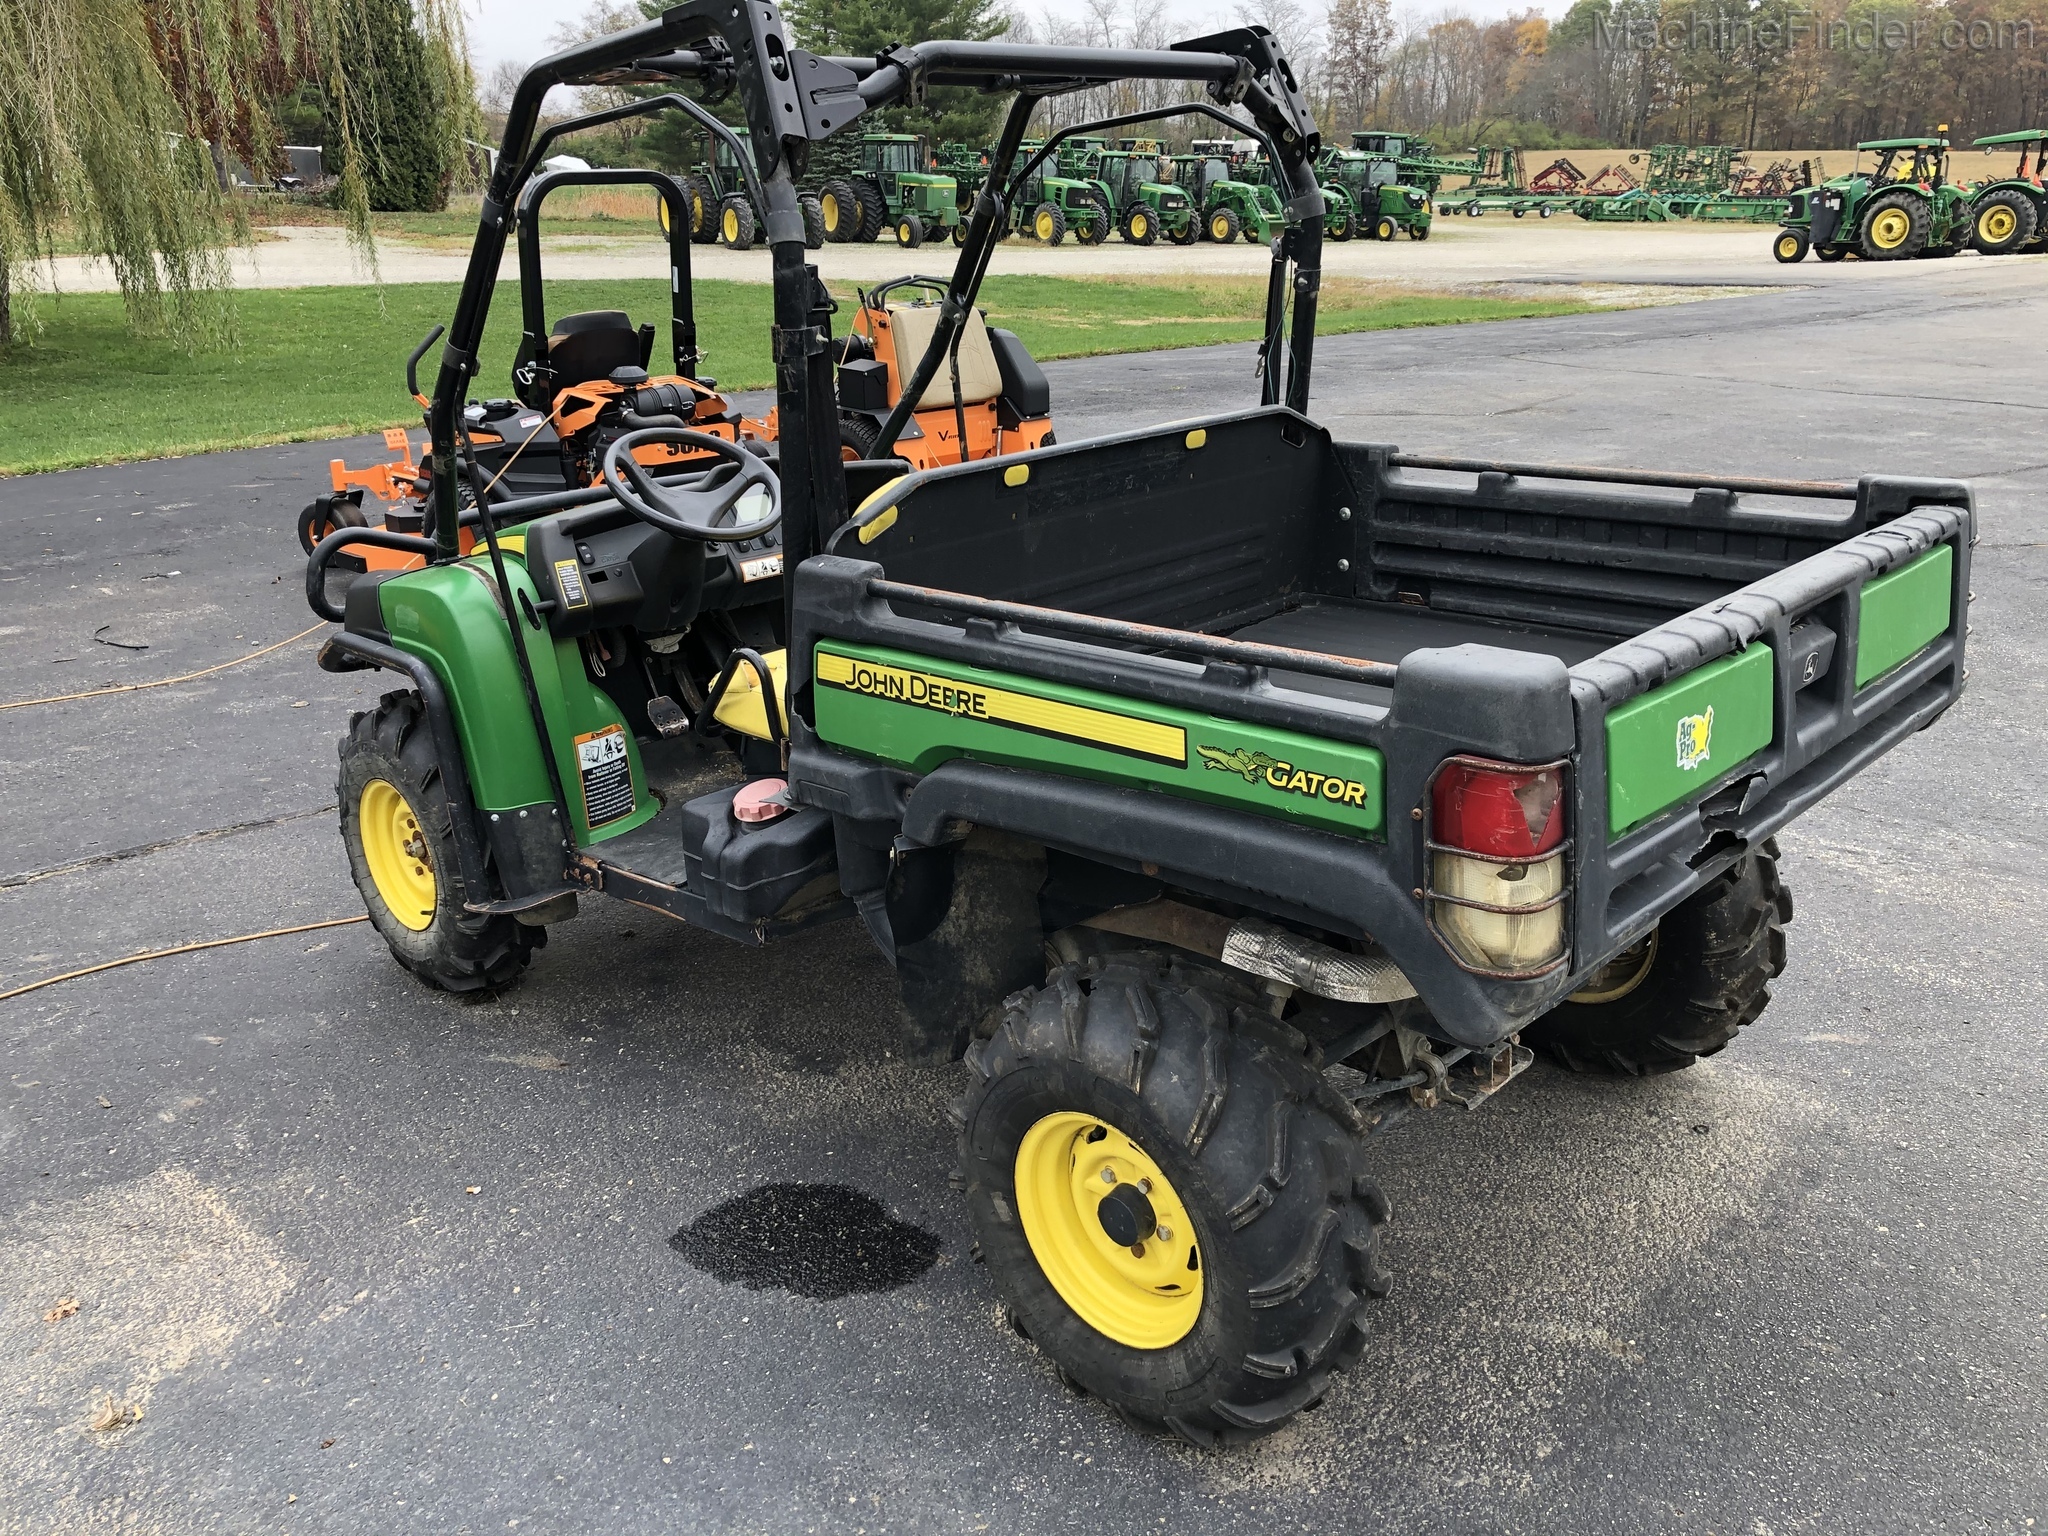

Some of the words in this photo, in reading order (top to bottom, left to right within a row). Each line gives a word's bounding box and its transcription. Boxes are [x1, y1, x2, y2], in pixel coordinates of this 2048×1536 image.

[845, 663, 904, 697] JOHN
[910, 674, 987, 715] DEERE
[1679, 739, 1696, 761] Pro
[1265, 761, 1367, 807] GATOR
